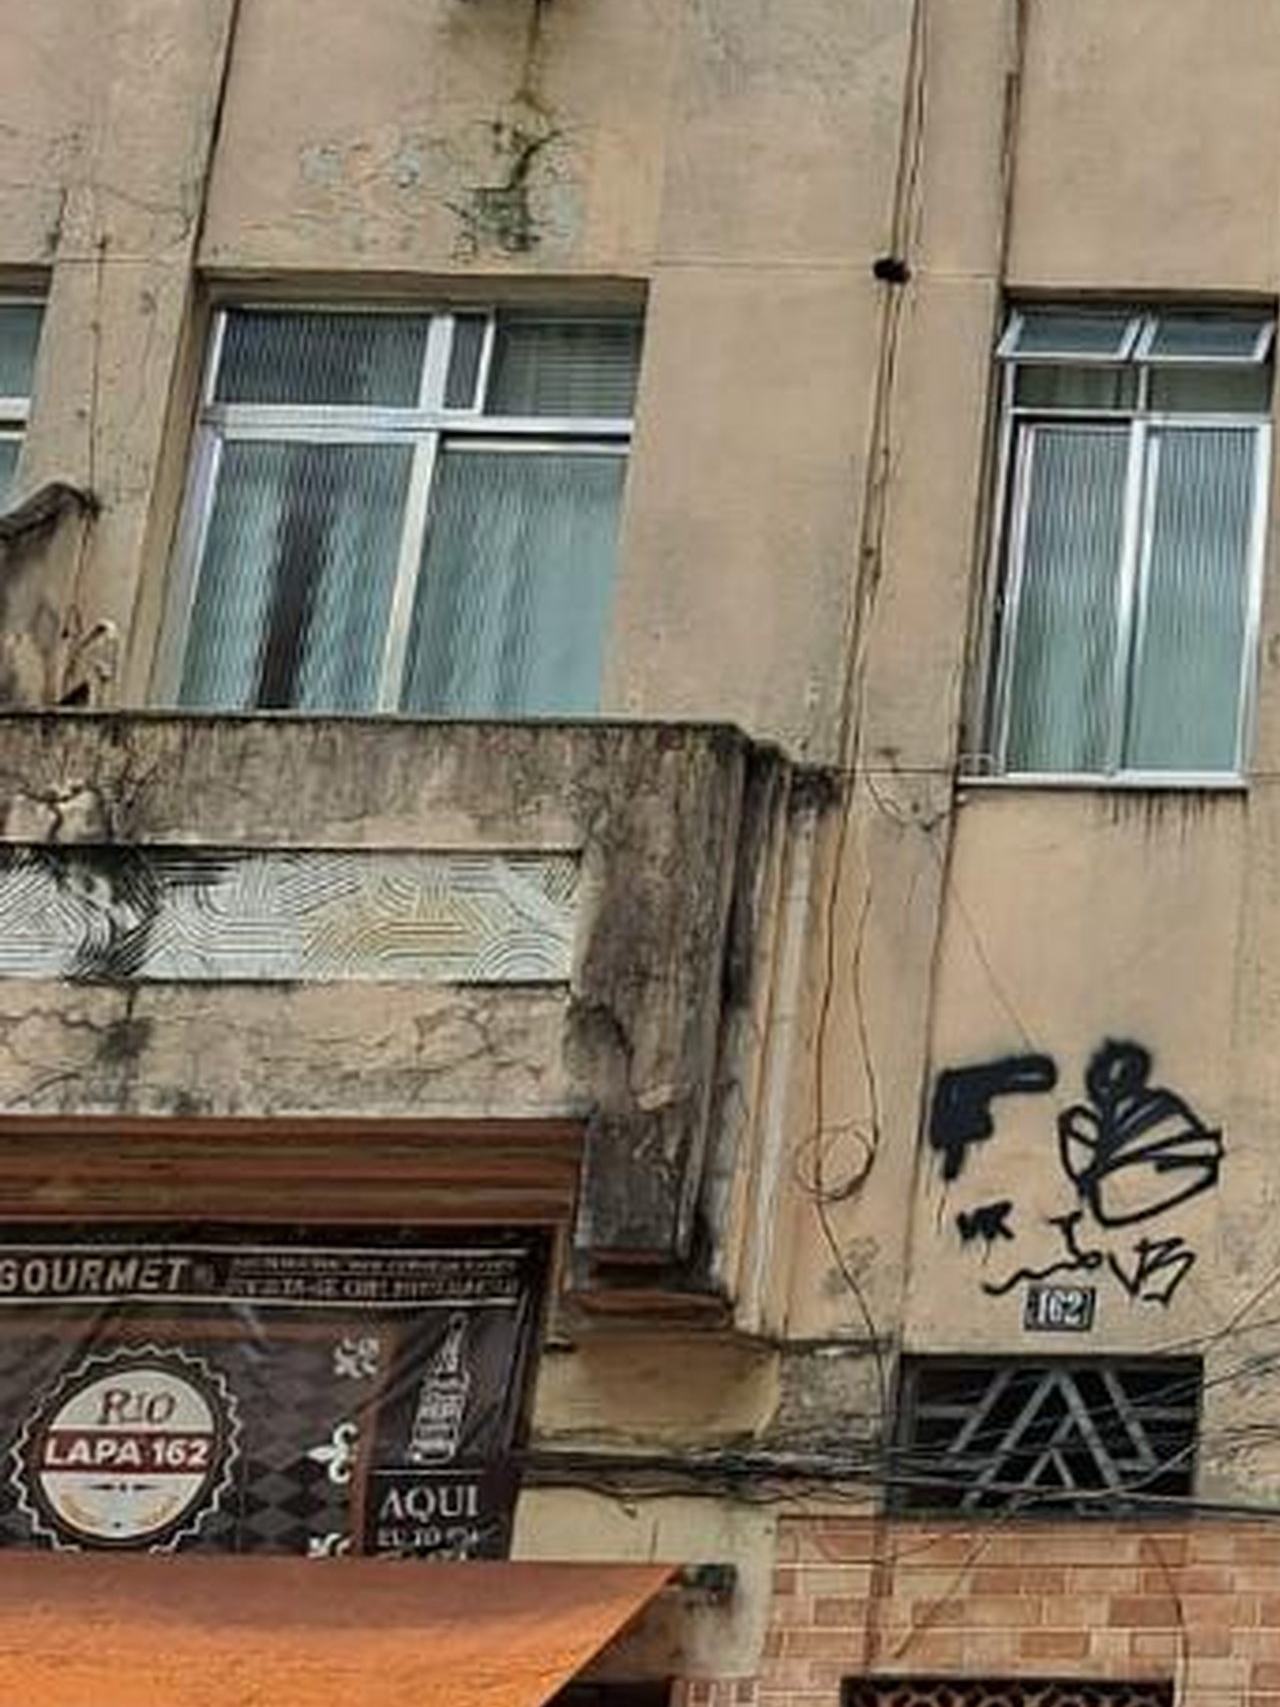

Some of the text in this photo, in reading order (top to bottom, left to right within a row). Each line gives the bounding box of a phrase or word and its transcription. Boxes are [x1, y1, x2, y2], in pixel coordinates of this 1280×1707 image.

[0, 1257, 190, 1293] GOURMET
[1035, 1289, 1085, 1327] 162
[98, 1388, 176, 1426] RIO
[44, 1437, 209, 1467] LAPA 162
[378, 1484, 480, 1523] AQUI
